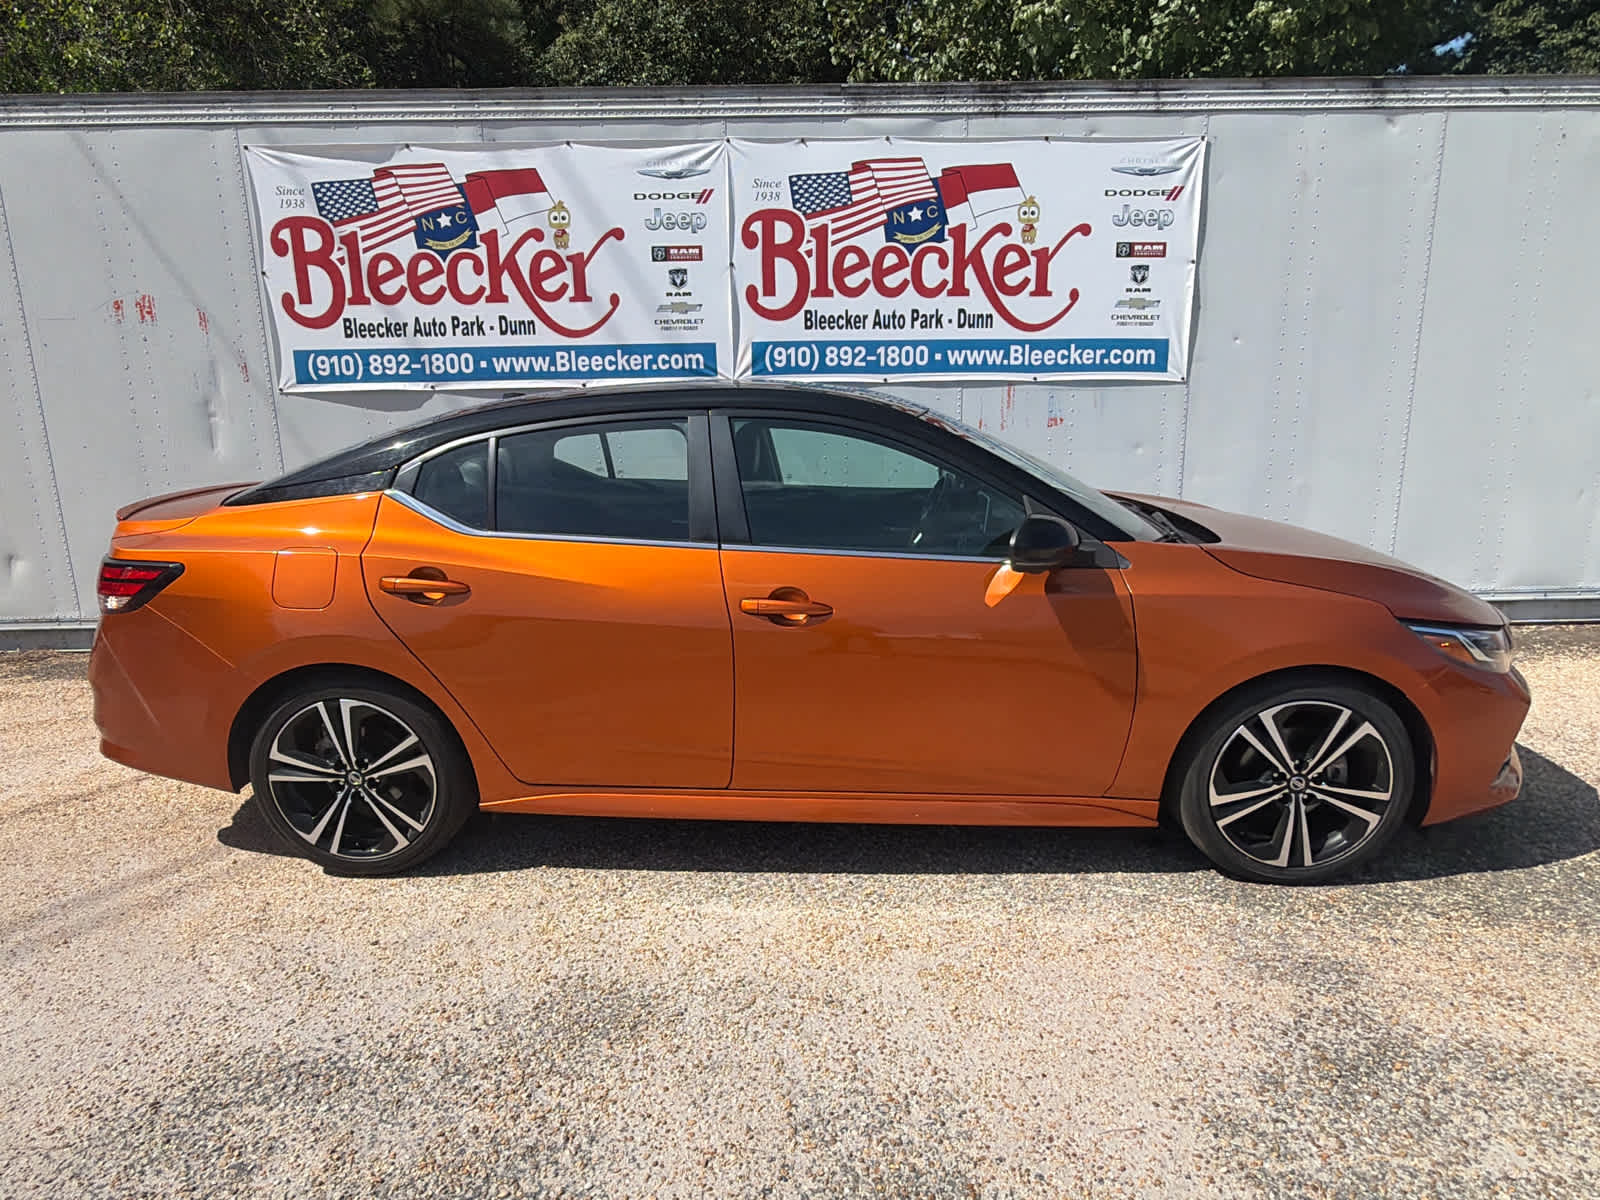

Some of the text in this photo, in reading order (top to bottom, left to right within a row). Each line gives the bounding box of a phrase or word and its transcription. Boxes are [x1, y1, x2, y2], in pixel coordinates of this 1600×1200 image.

[275, 185, 305, 196] Since
[752, 178, 782, 189] Since
[1104, 189, 1172, 197] DODGE
[280, 198, 305, 209] 1938
[633, 192, 704, 201] DODGE
[754, 191, 781, 201] 1938
[421, 211, 468, 232] N C
[644, 208, 707, 234] Jeep
[892, 205, 939, 225] N C
[1111, 204, 1175, 231] Jeep
[270, 215, 625, 339] Bleecker
[741, 208, 1092, 333] Bleecker
[343, 315, 536, 339] Bleecker Auto Park Dunn
[804, 308, 993, 330] Bleecker Auto Park Dunn
[308, 349, 704, 381] (910) 892-1800 www.Bleecker.com
[765, 343, 1155, 372] (910) 892-1800 www.Bleecker.com
